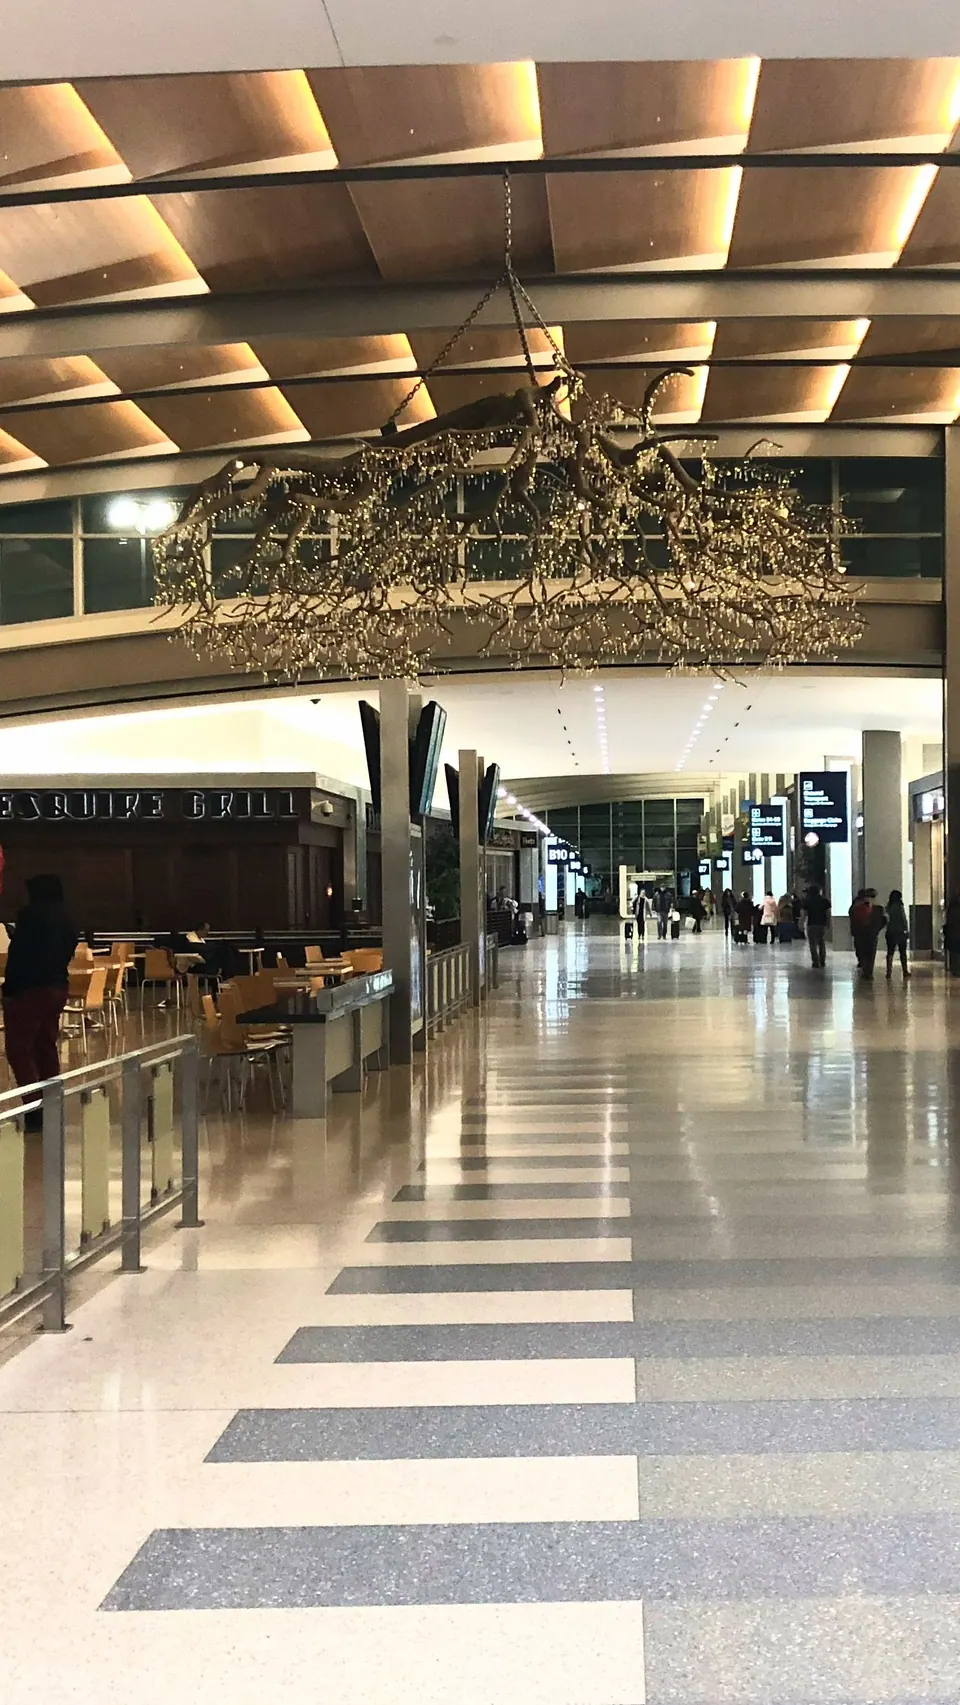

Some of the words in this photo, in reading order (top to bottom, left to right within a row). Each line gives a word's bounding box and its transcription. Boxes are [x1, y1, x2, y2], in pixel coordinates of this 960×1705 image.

[0, 791, 165, 821] ESQUIRE
[182, 791, 300, 820] GRILL
[549, 849, 568, 860] B10
